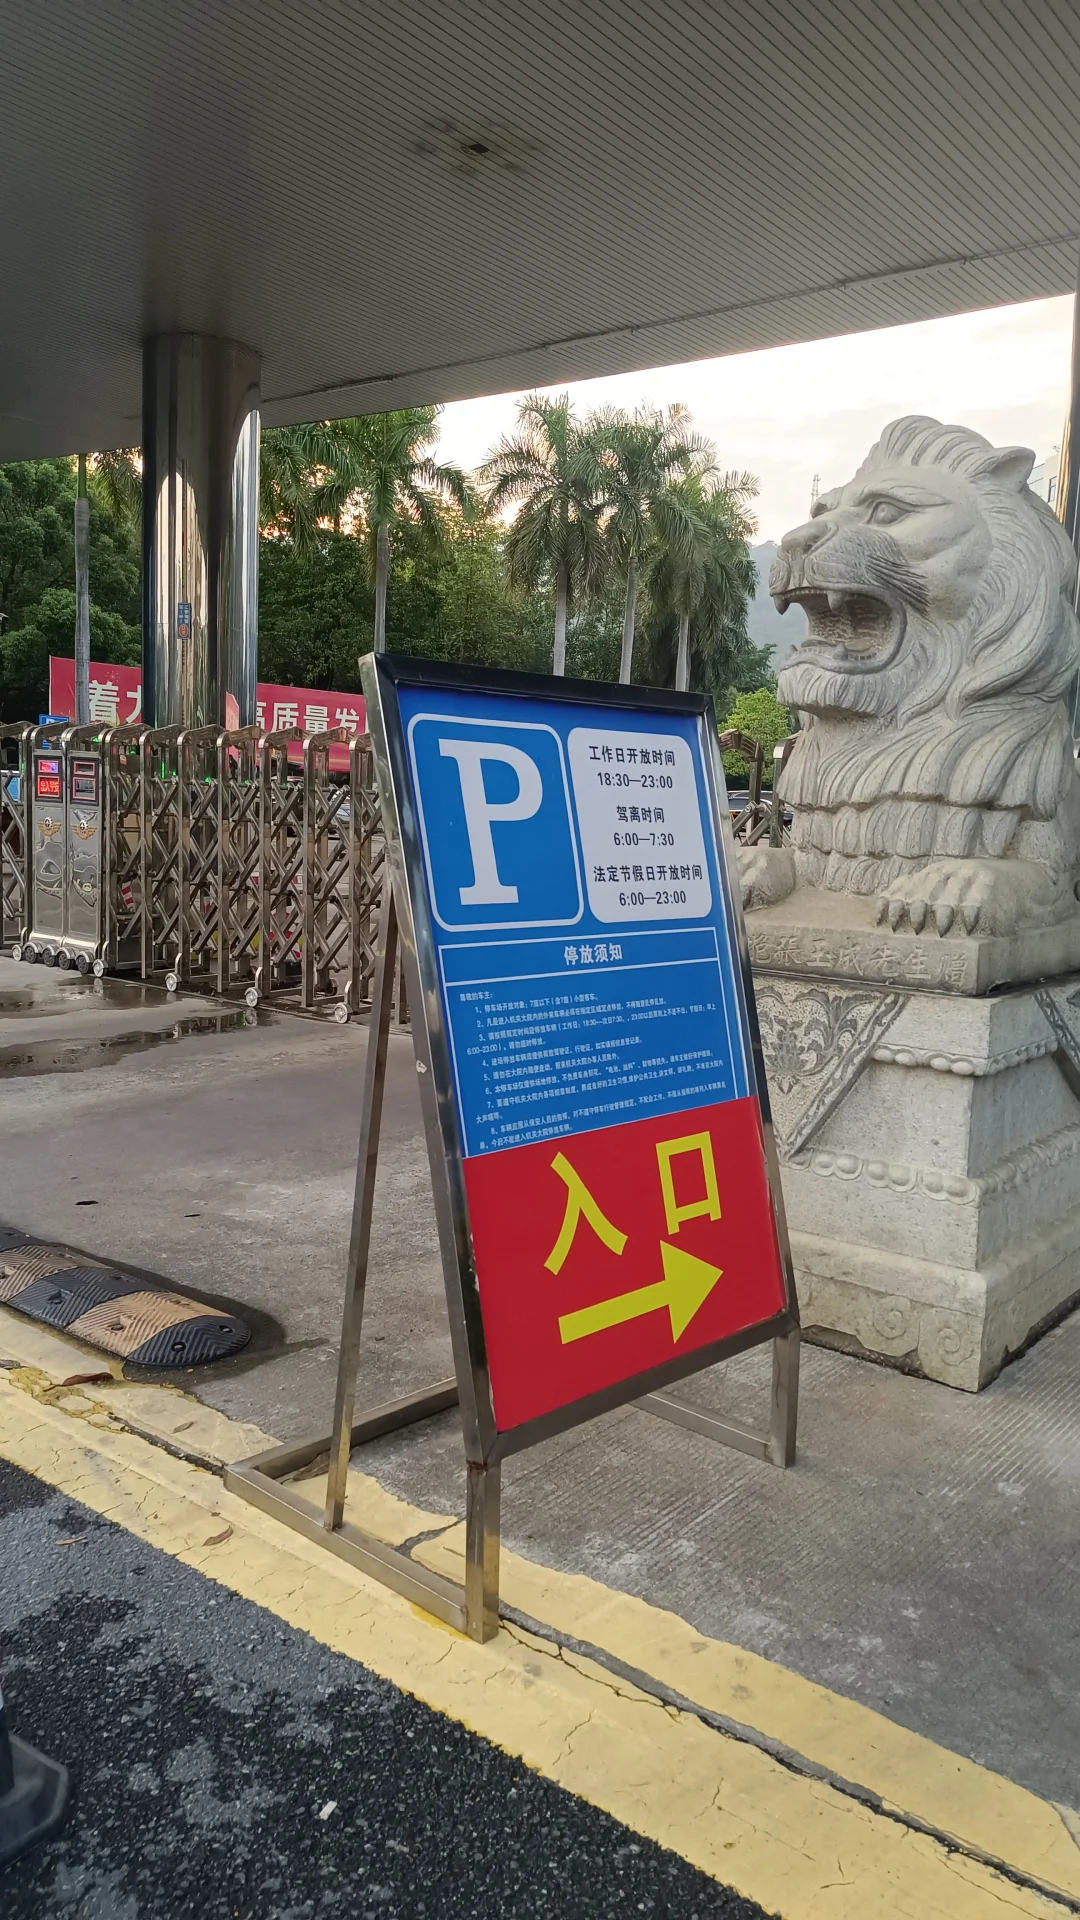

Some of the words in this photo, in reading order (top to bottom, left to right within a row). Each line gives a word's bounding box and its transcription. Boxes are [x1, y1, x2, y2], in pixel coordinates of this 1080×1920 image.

[256, 701, 368, 734] 质量发
[589, 746, 675, 766] 工作日开放时间
[597, 772, 673, 789] 18:30—23:00
[438, 738, 543, 906] P
[616, 806, 665, 823] 驾离时间
[613, 832, 674, 846] 6:00—7:30
[593, 865, 703, 882] 法定节假日开放时间
[619, 890, 687, 906] 6:00—23:00
[563, 943, 624, 966] 停放须知
[543, 1131, 722, 1275] 入口
